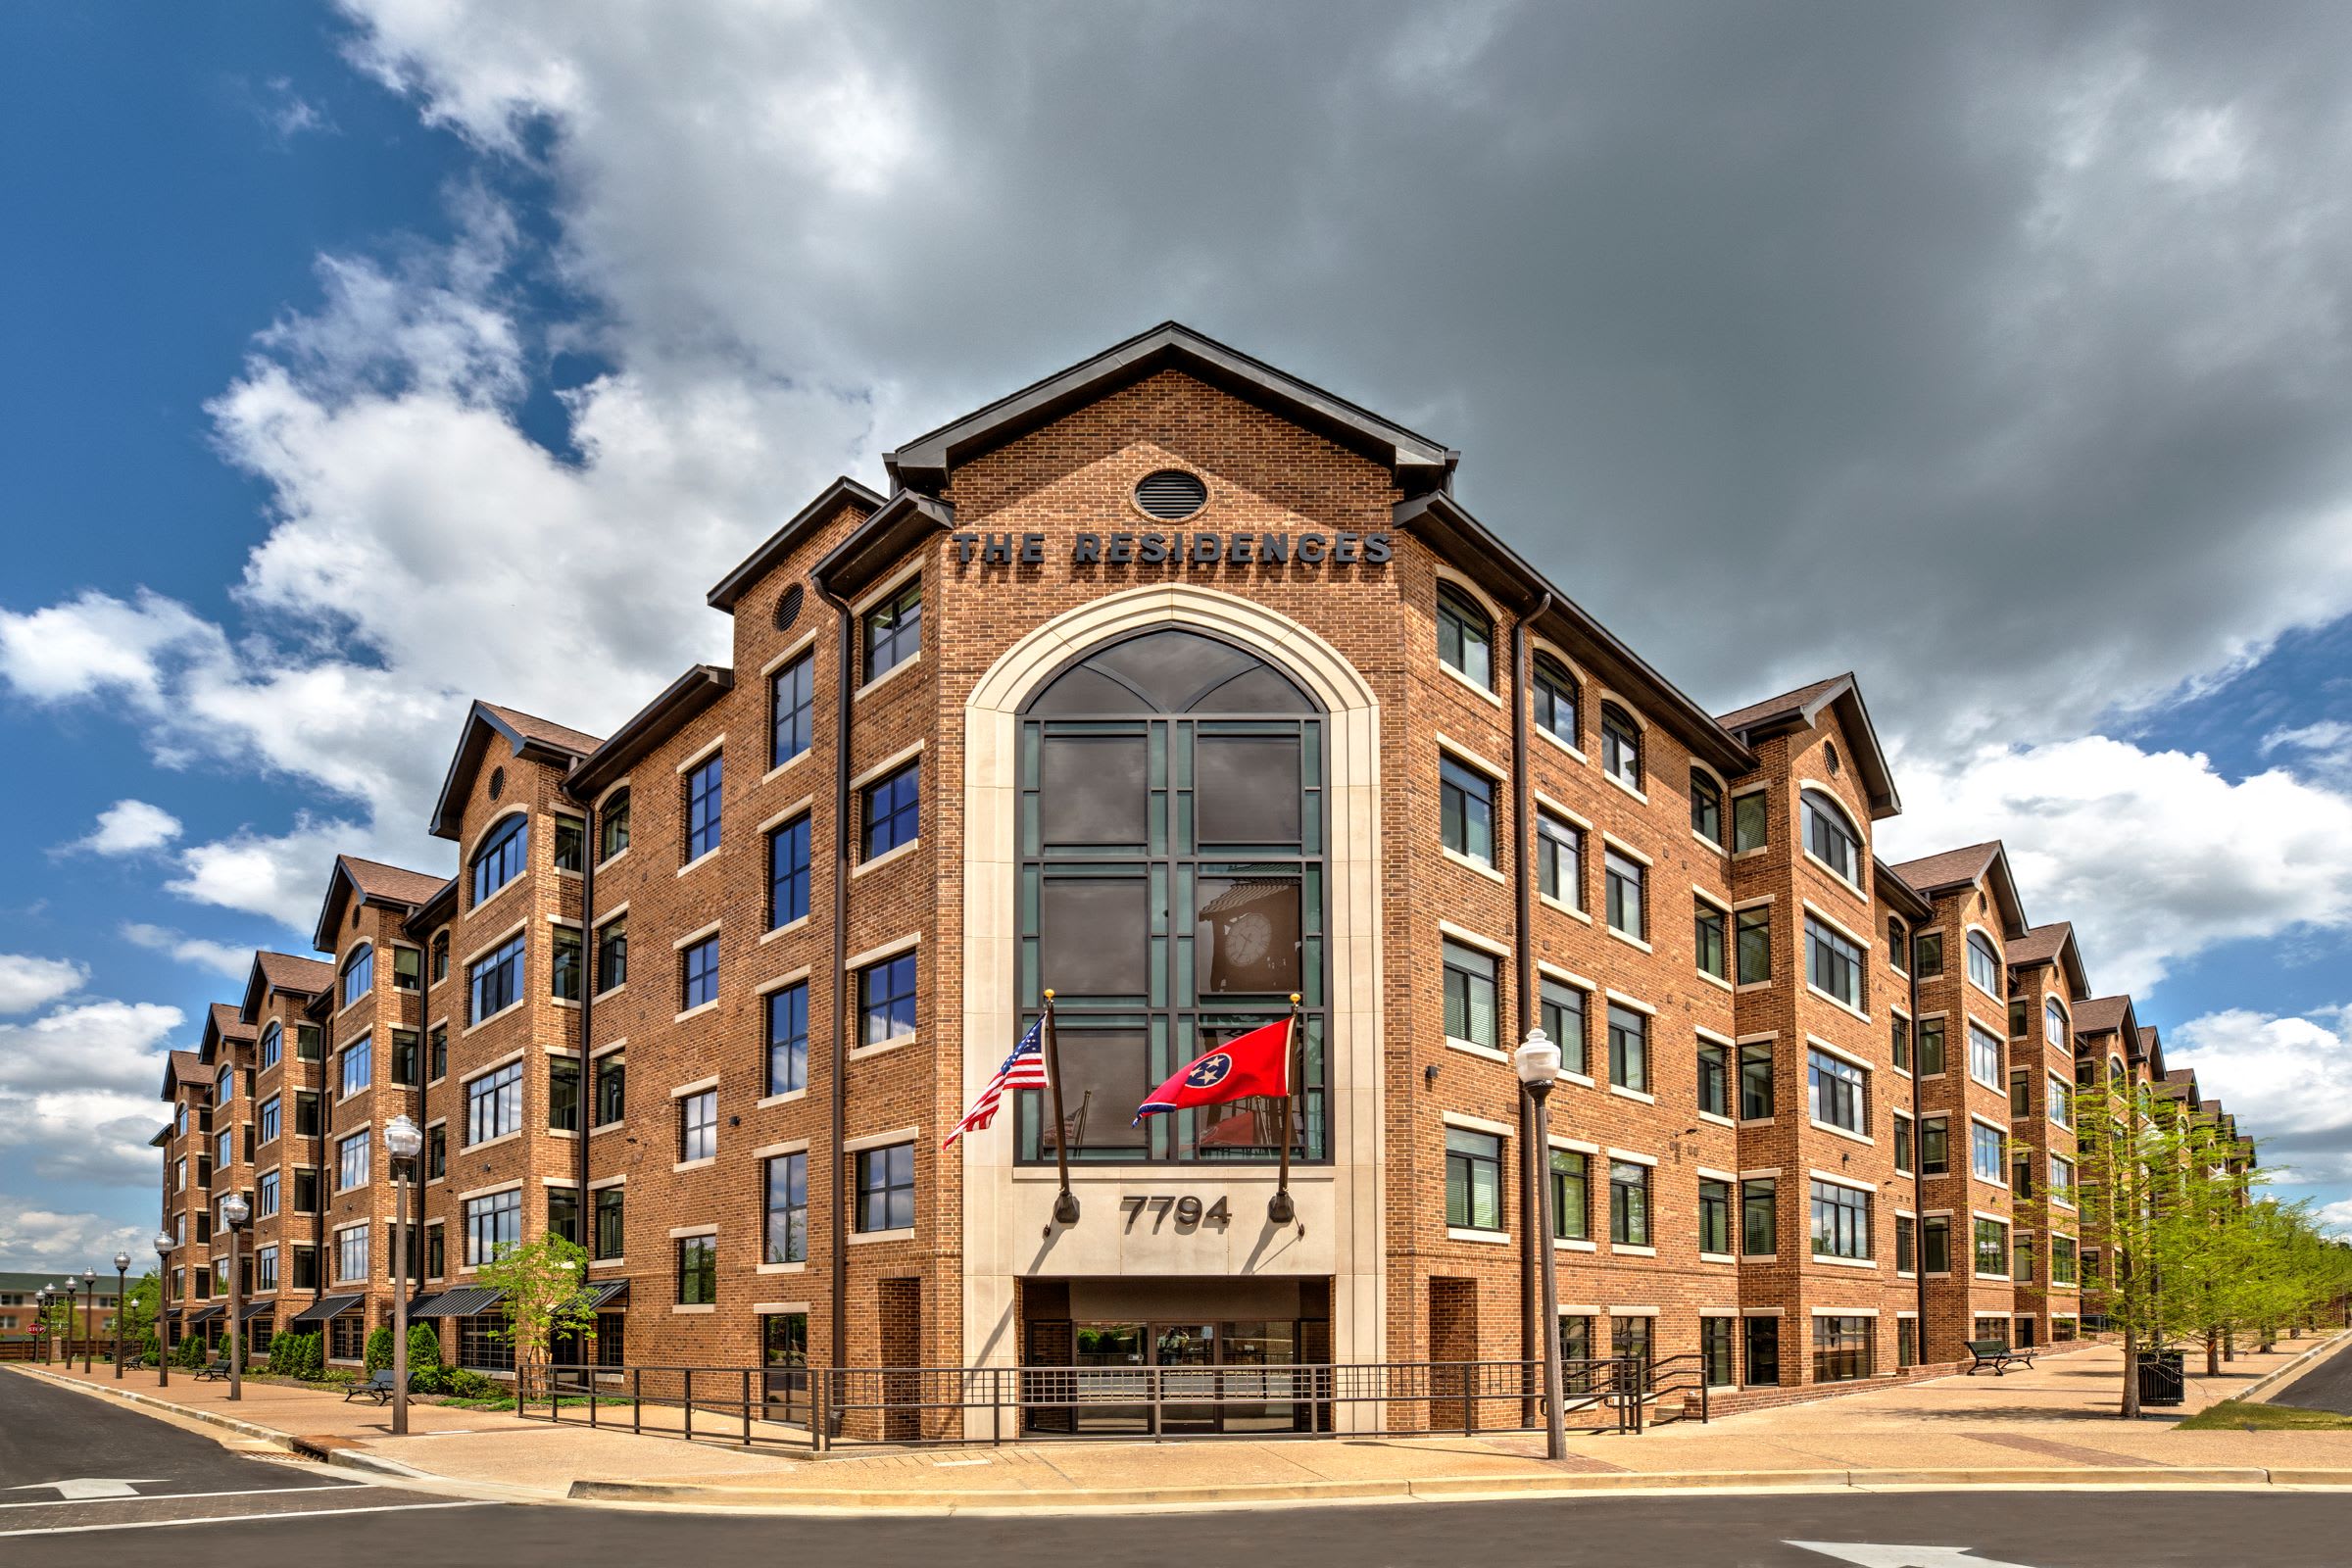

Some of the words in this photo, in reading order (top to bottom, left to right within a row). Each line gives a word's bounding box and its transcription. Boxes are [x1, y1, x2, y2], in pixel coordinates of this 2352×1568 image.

[953, 533, 1045, 564] THE
[1076, 532, 1392, 564] RESIDENCES
[1122, 1196, 1232, 1225] 7794
